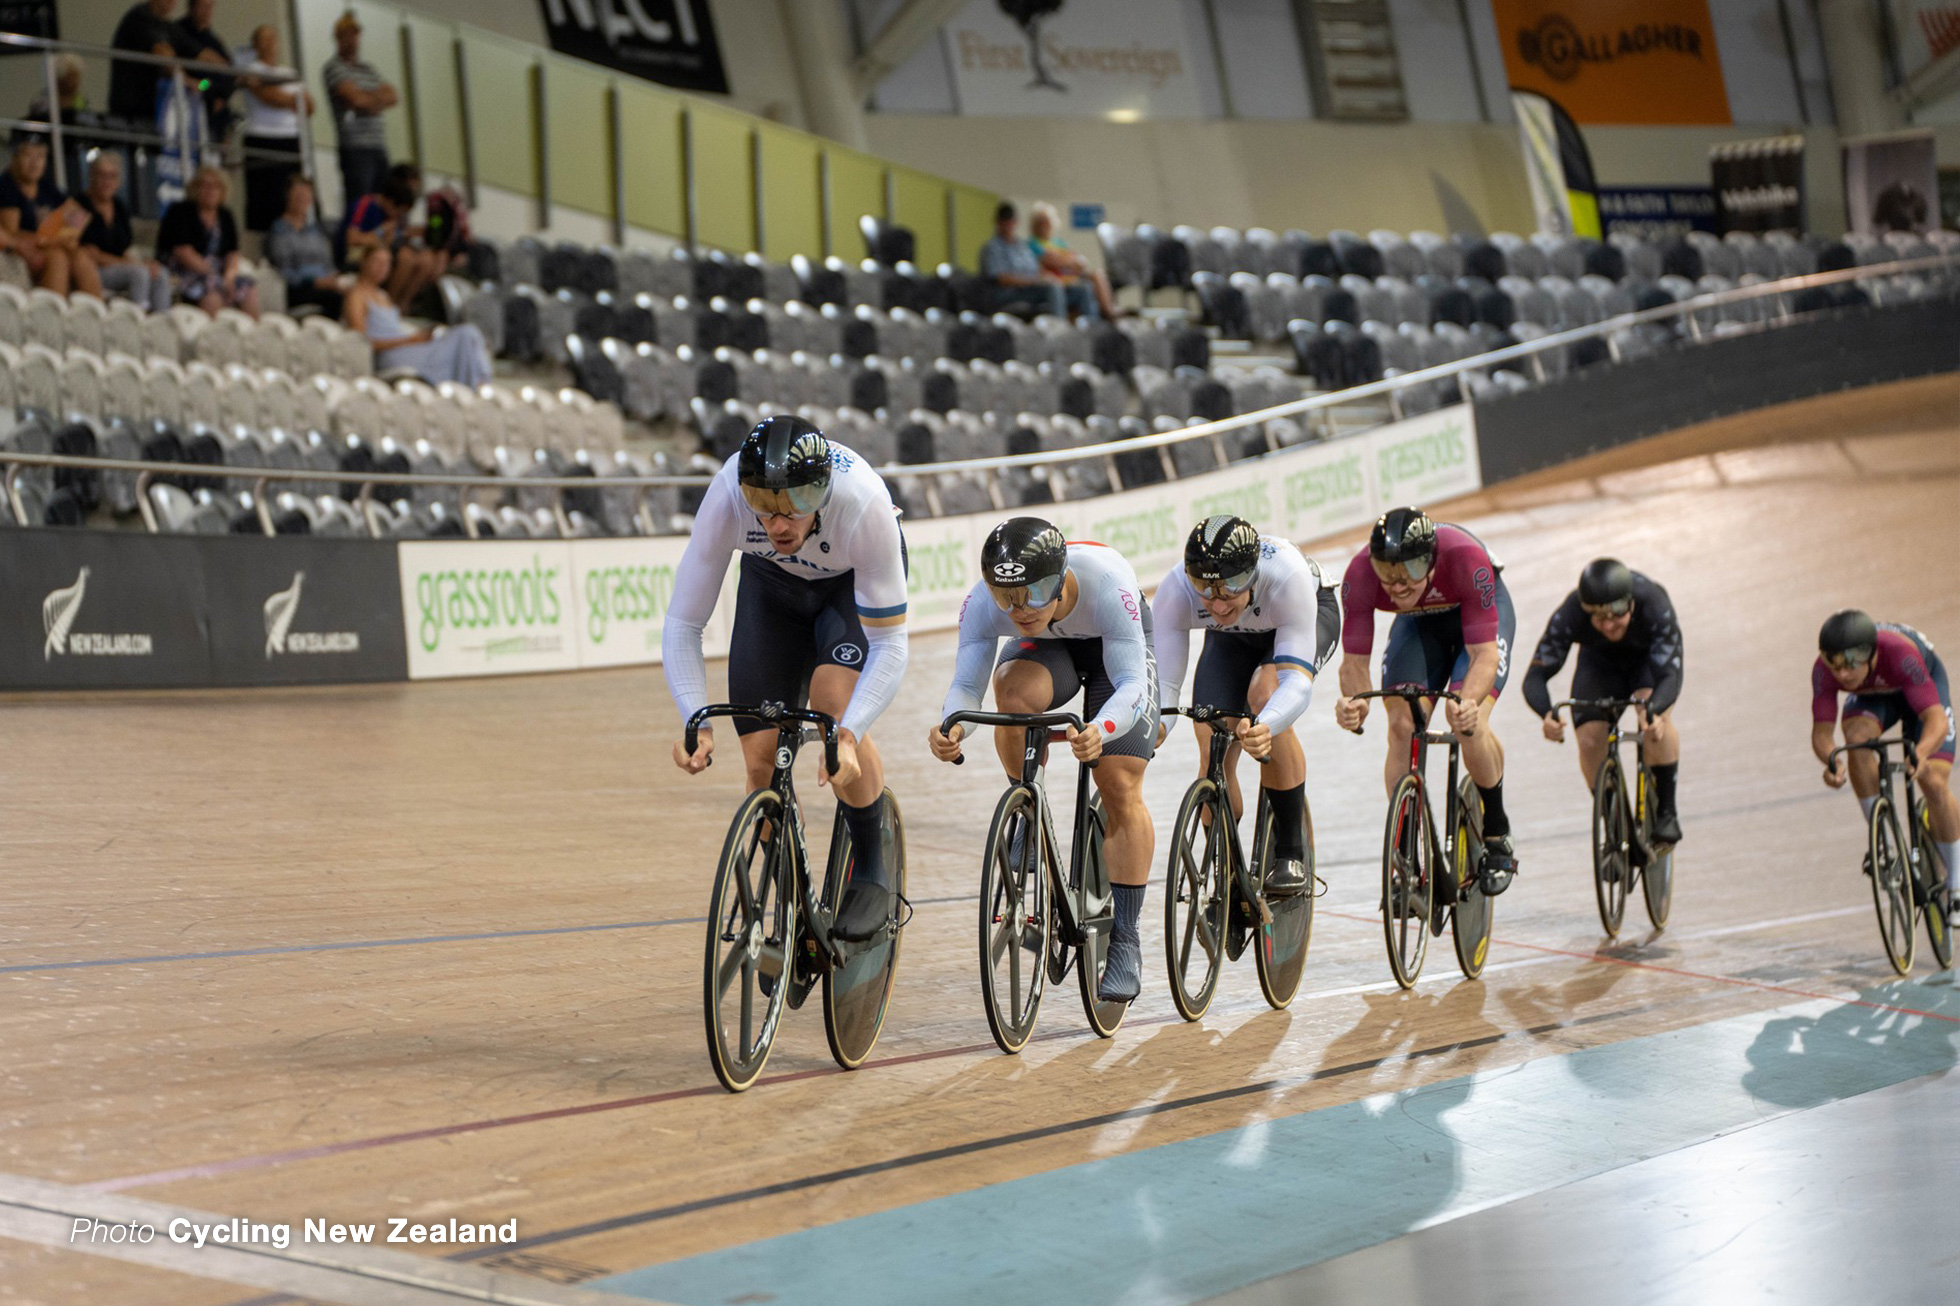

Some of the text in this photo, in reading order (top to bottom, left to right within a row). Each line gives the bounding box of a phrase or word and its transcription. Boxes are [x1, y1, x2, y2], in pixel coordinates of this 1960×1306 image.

[417, 552, 561, 653] grassroots
[586, 564, 676, 645] grassro
[1474, 566, 1496, 611] QAS
